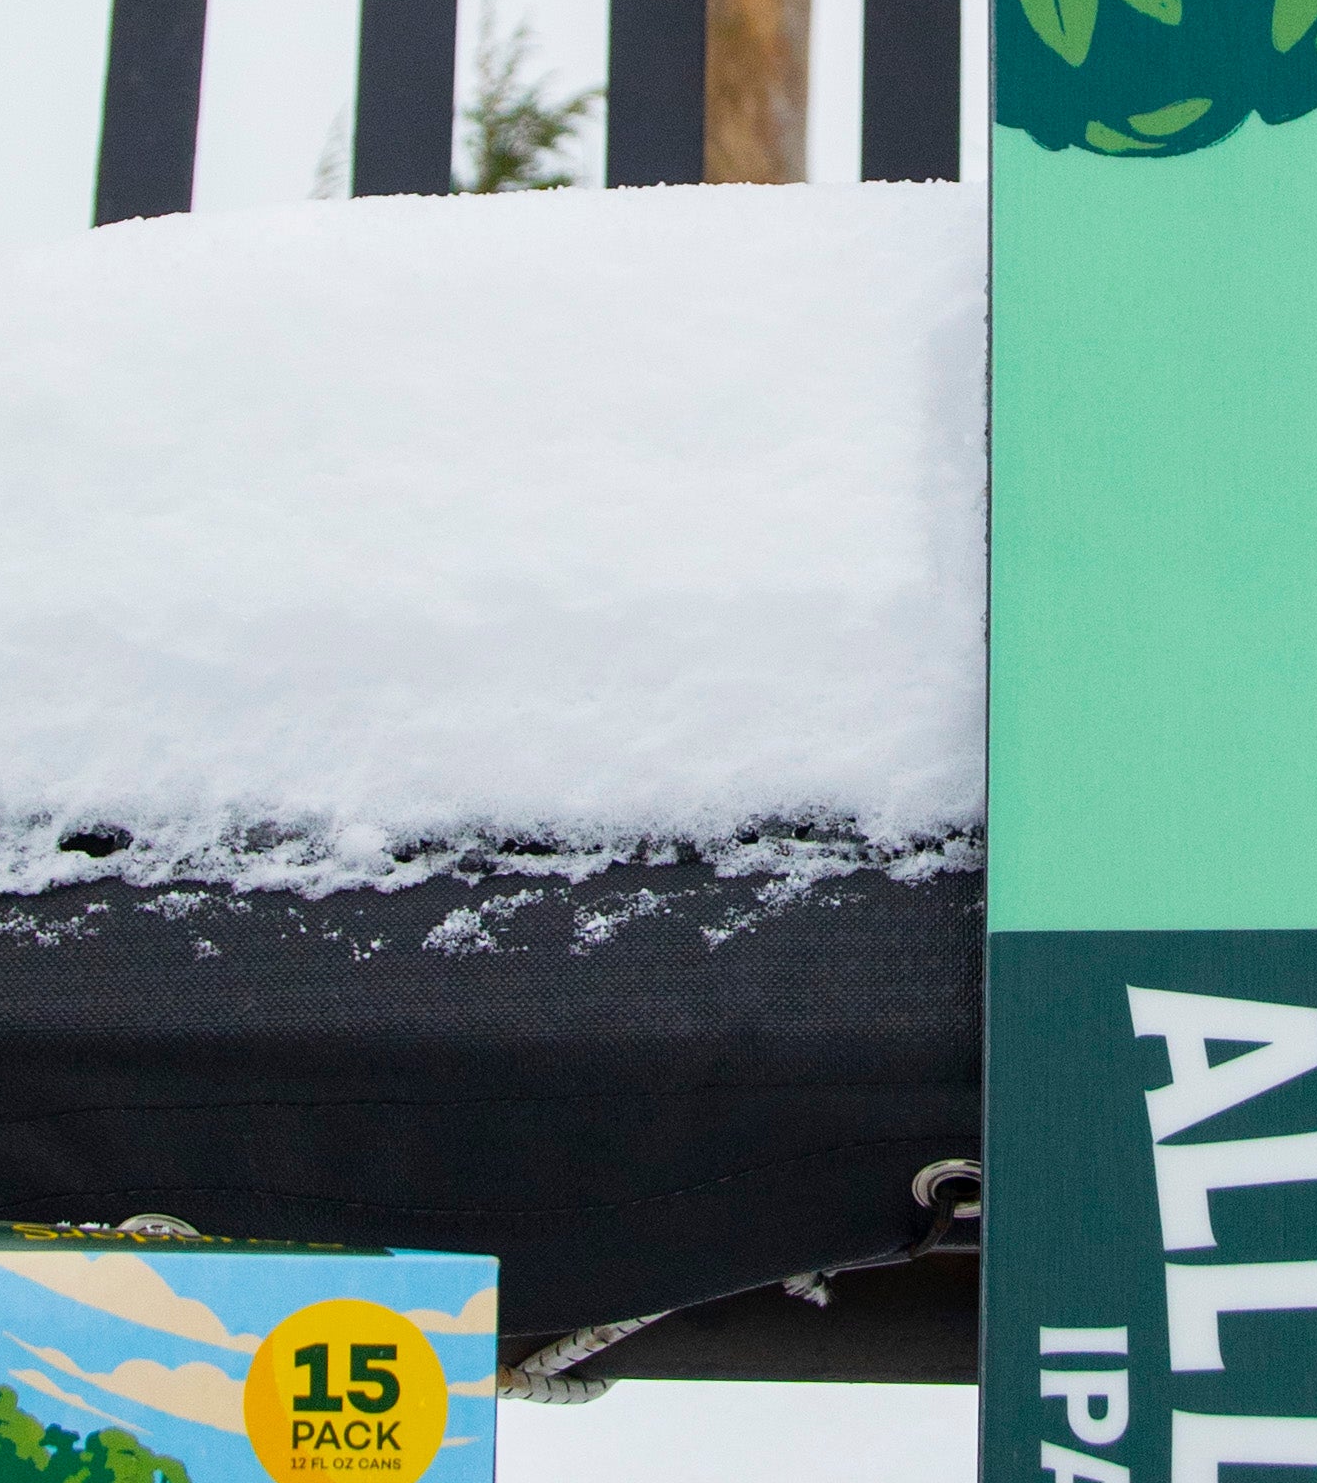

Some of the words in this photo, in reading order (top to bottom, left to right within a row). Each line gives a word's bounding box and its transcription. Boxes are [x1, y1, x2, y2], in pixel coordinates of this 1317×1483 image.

[292, 1342, 400, 1415] 15
[291, 1419, 402, 1451] PACK
[290, 1457, 307, 1470] 12
[311, 1457, 328, 1470] FL
[332, 1457, 353, 1470] OZ
[357, 1457, 402, 1470] CANS
